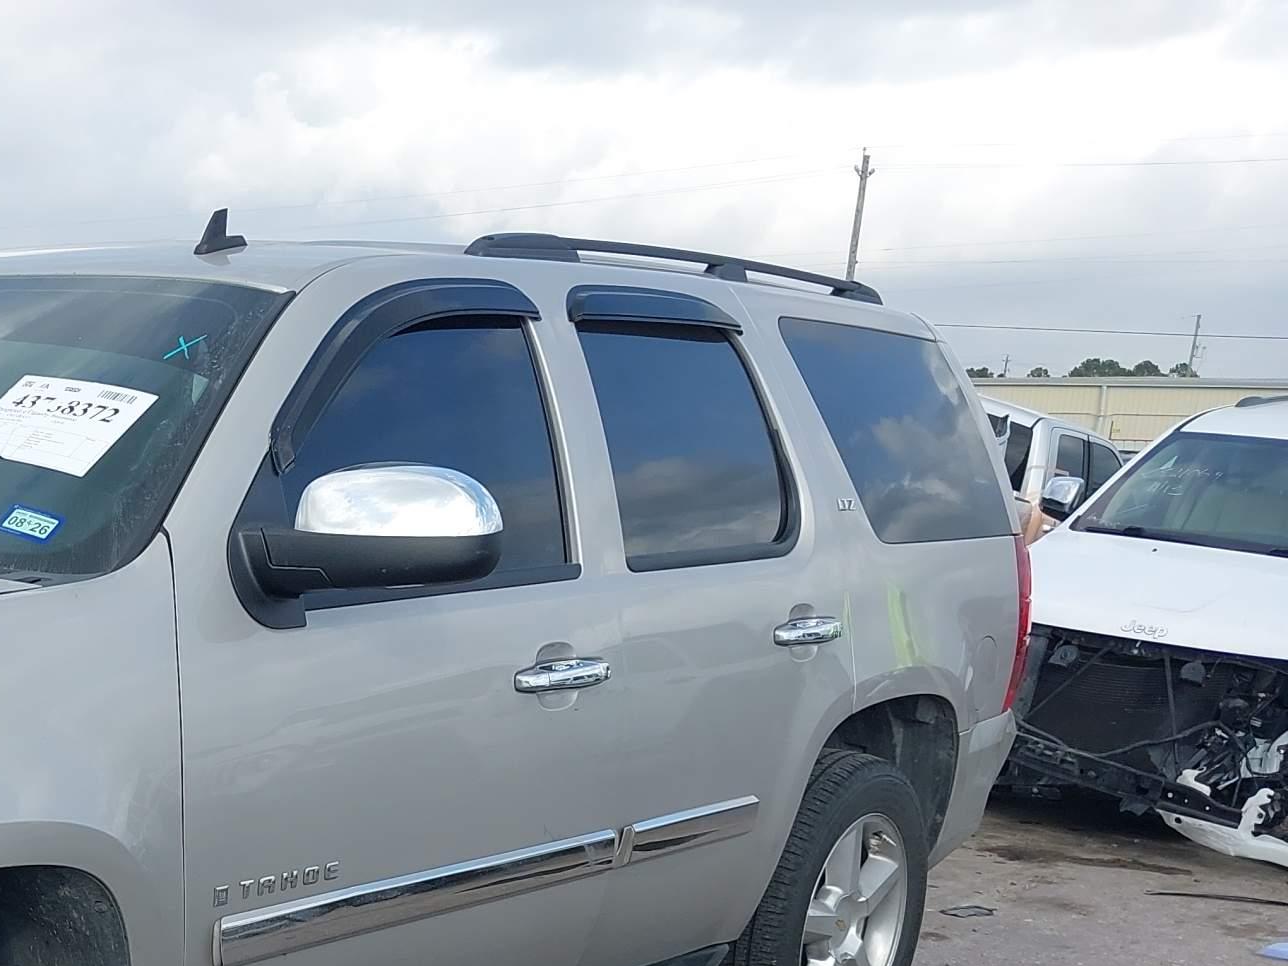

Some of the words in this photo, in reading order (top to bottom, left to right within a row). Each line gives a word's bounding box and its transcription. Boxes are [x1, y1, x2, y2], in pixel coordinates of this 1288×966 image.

[7, 515, 27, 528] 08
[29, 522, 50, 535] 26
[1120, 620, 1168, 638] Jeep
[239, 861, 340, 899] TAHOE
